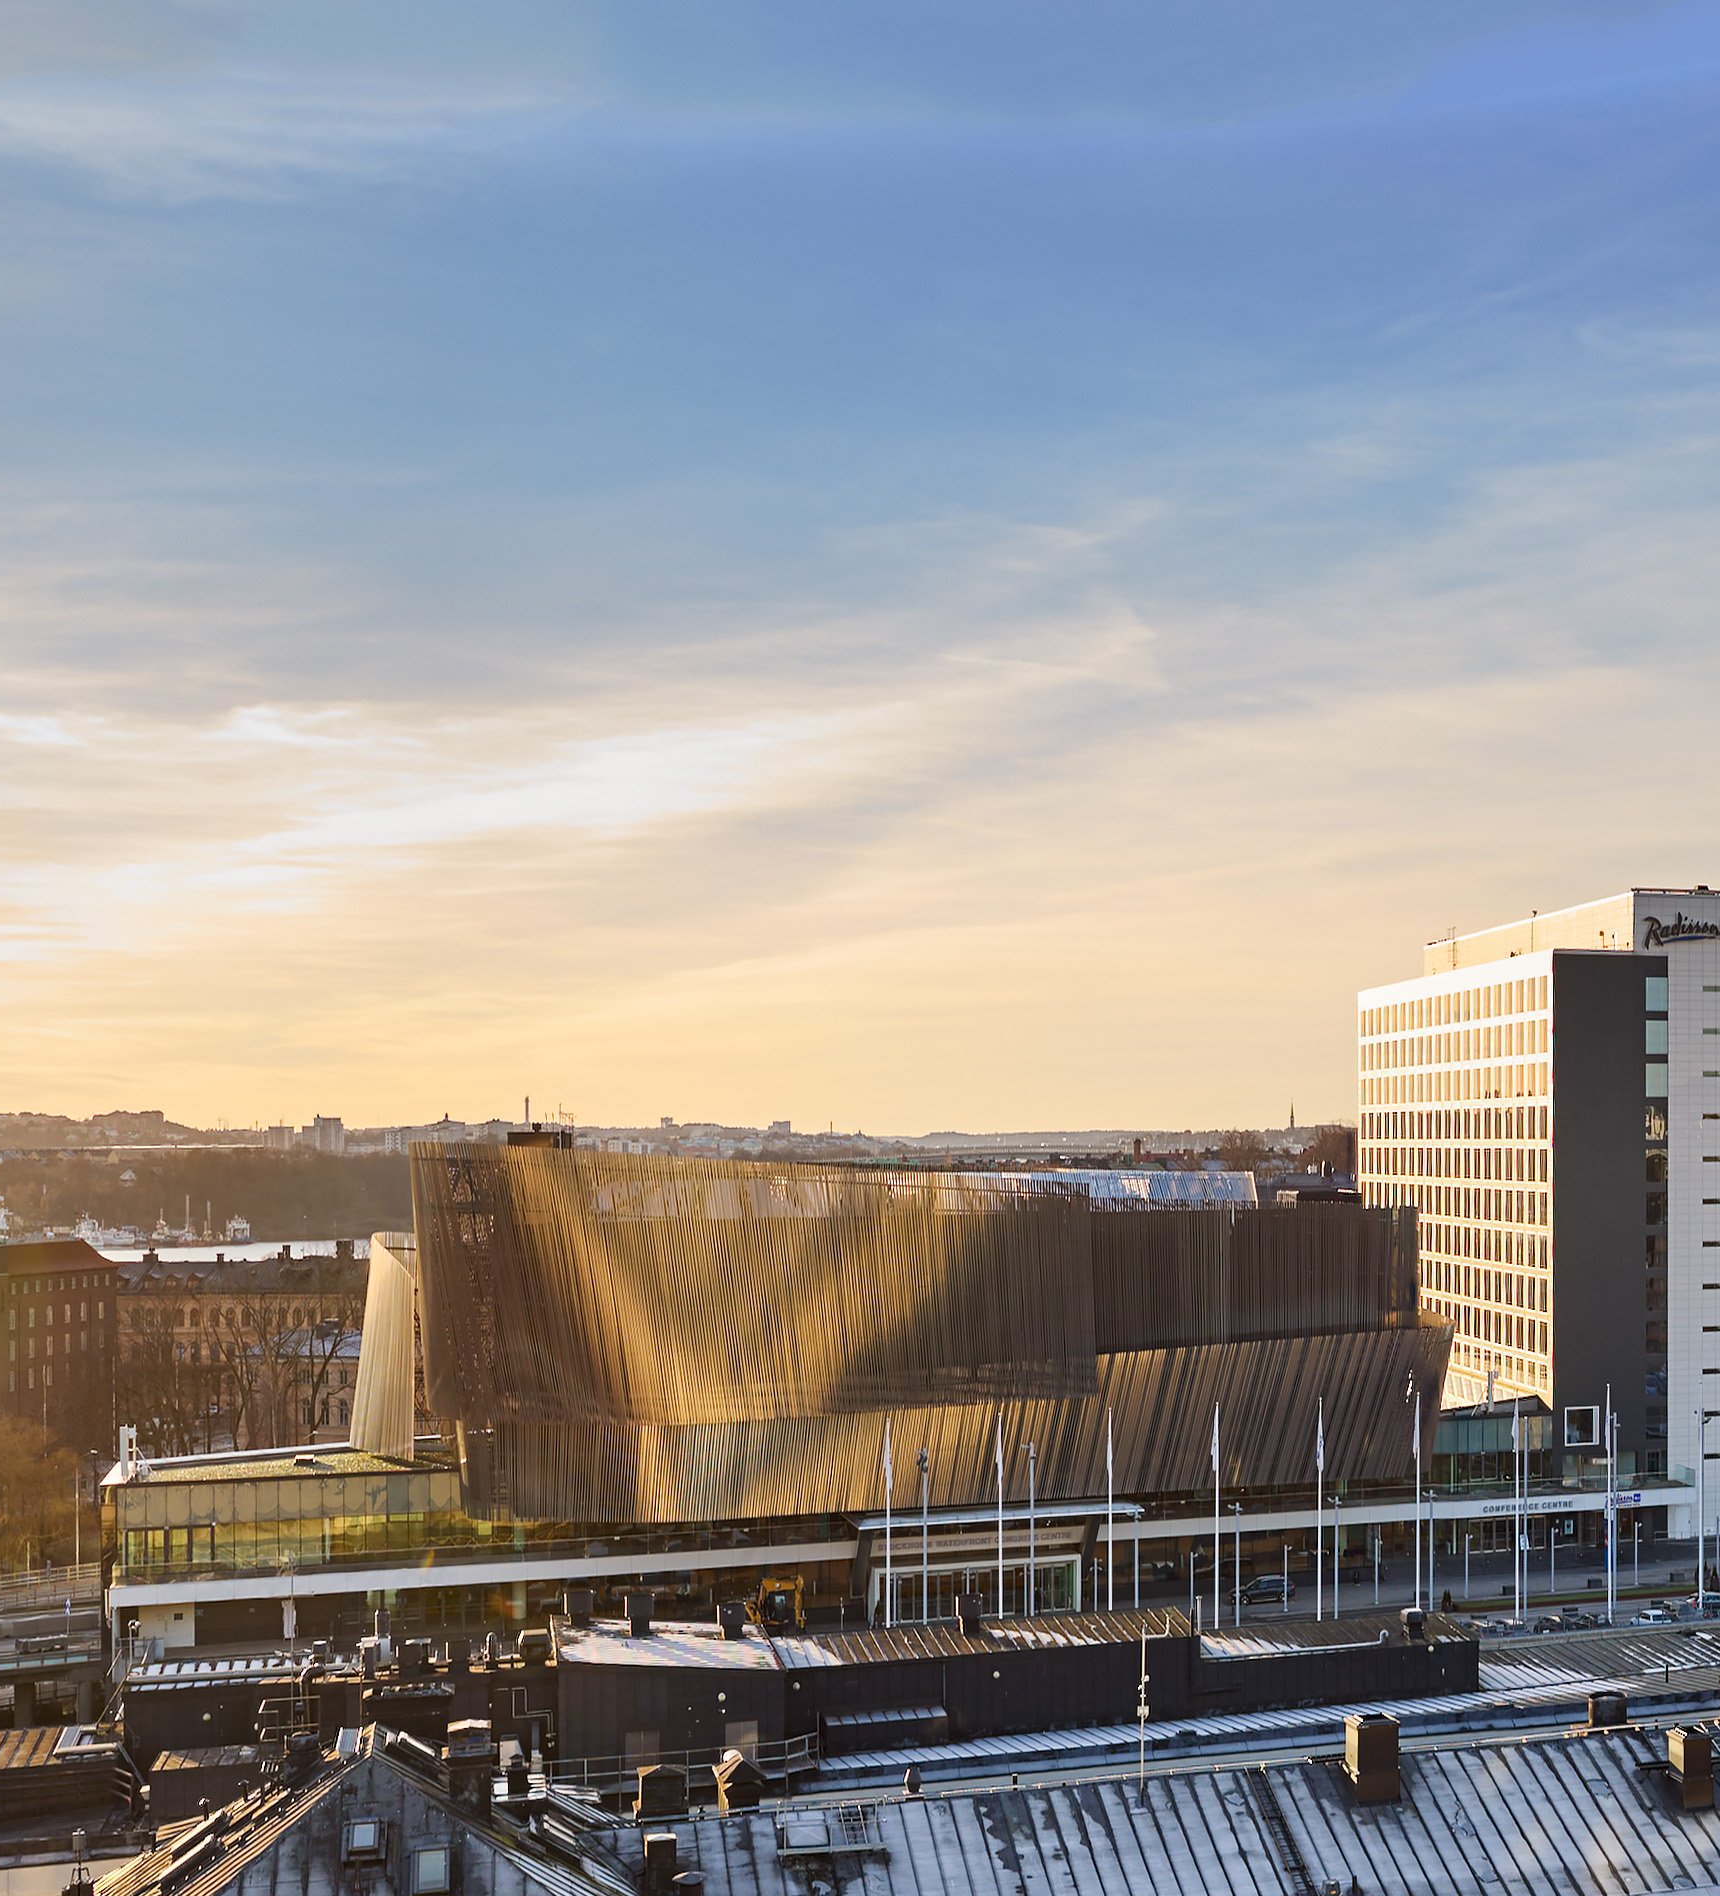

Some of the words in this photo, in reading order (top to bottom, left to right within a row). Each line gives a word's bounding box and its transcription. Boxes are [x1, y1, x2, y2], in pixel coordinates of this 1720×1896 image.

[1542, 1500, 1573, 1509] CENTRE
[936, 1537, 992, 1548] WATERFRONT
[1041, 1531, 1071, 1540] CENTRE
